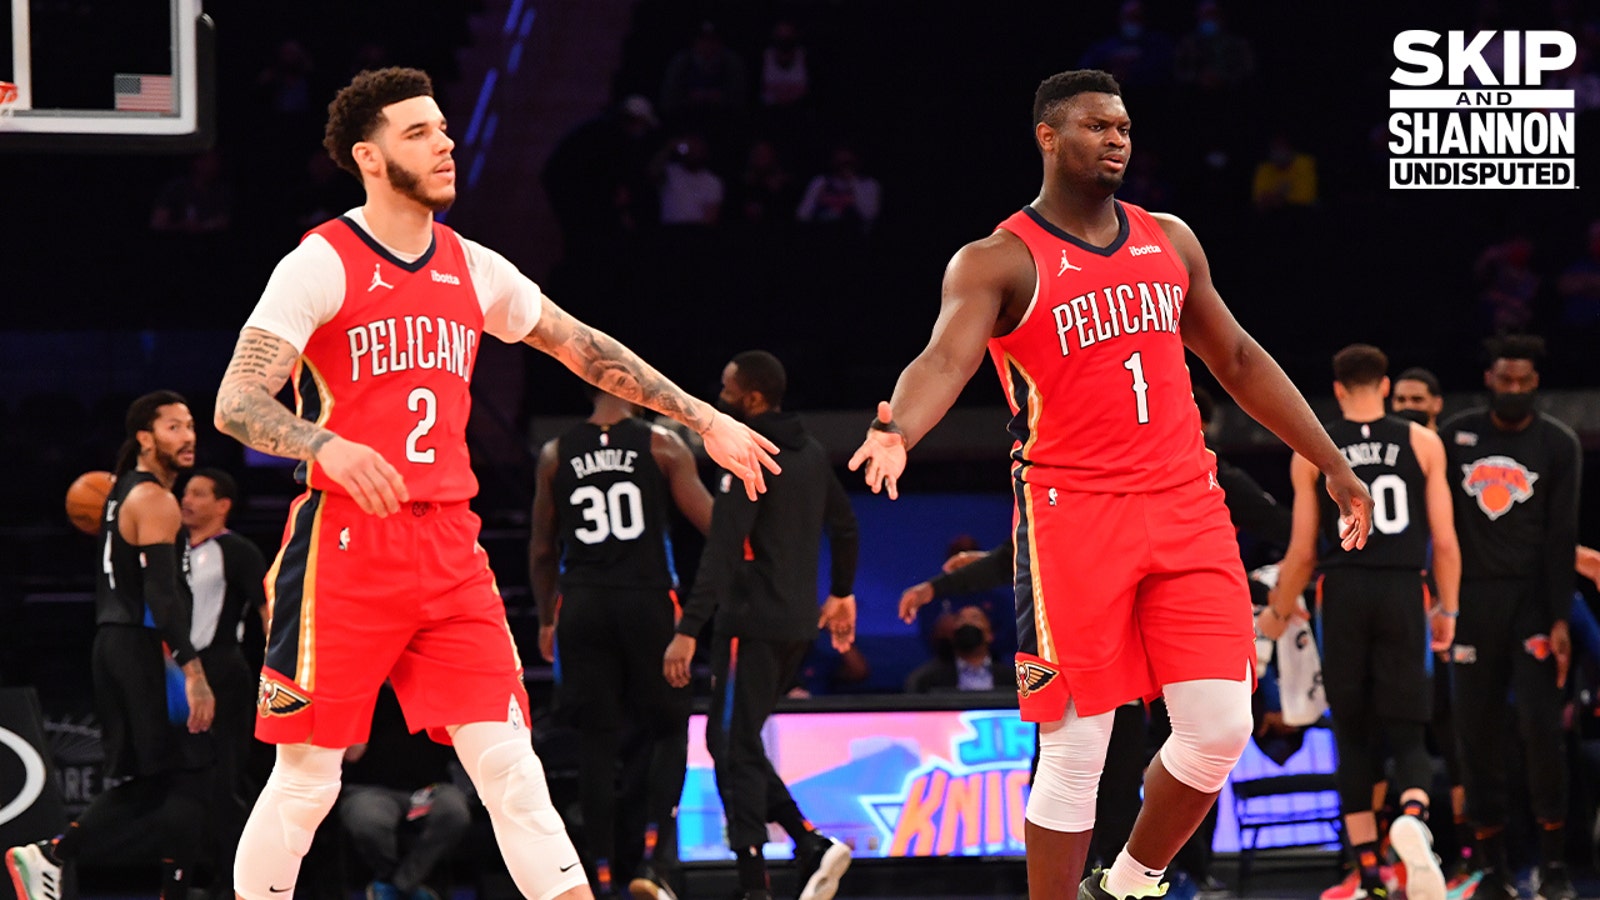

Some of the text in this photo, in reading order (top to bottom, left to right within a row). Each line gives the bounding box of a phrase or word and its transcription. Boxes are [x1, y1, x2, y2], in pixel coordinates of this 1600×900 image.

[431, 270, 460, 285] ibotta
[1129, 244, 1162, 257] ibotta
[347, 315, 476, 382] PELICANS
[1123, 351, 1149, 424] 1
[405, 387, 437, 464] 2
[570, 449, 638, 479] RANDLE
[570, 481, 645, 545] 30
